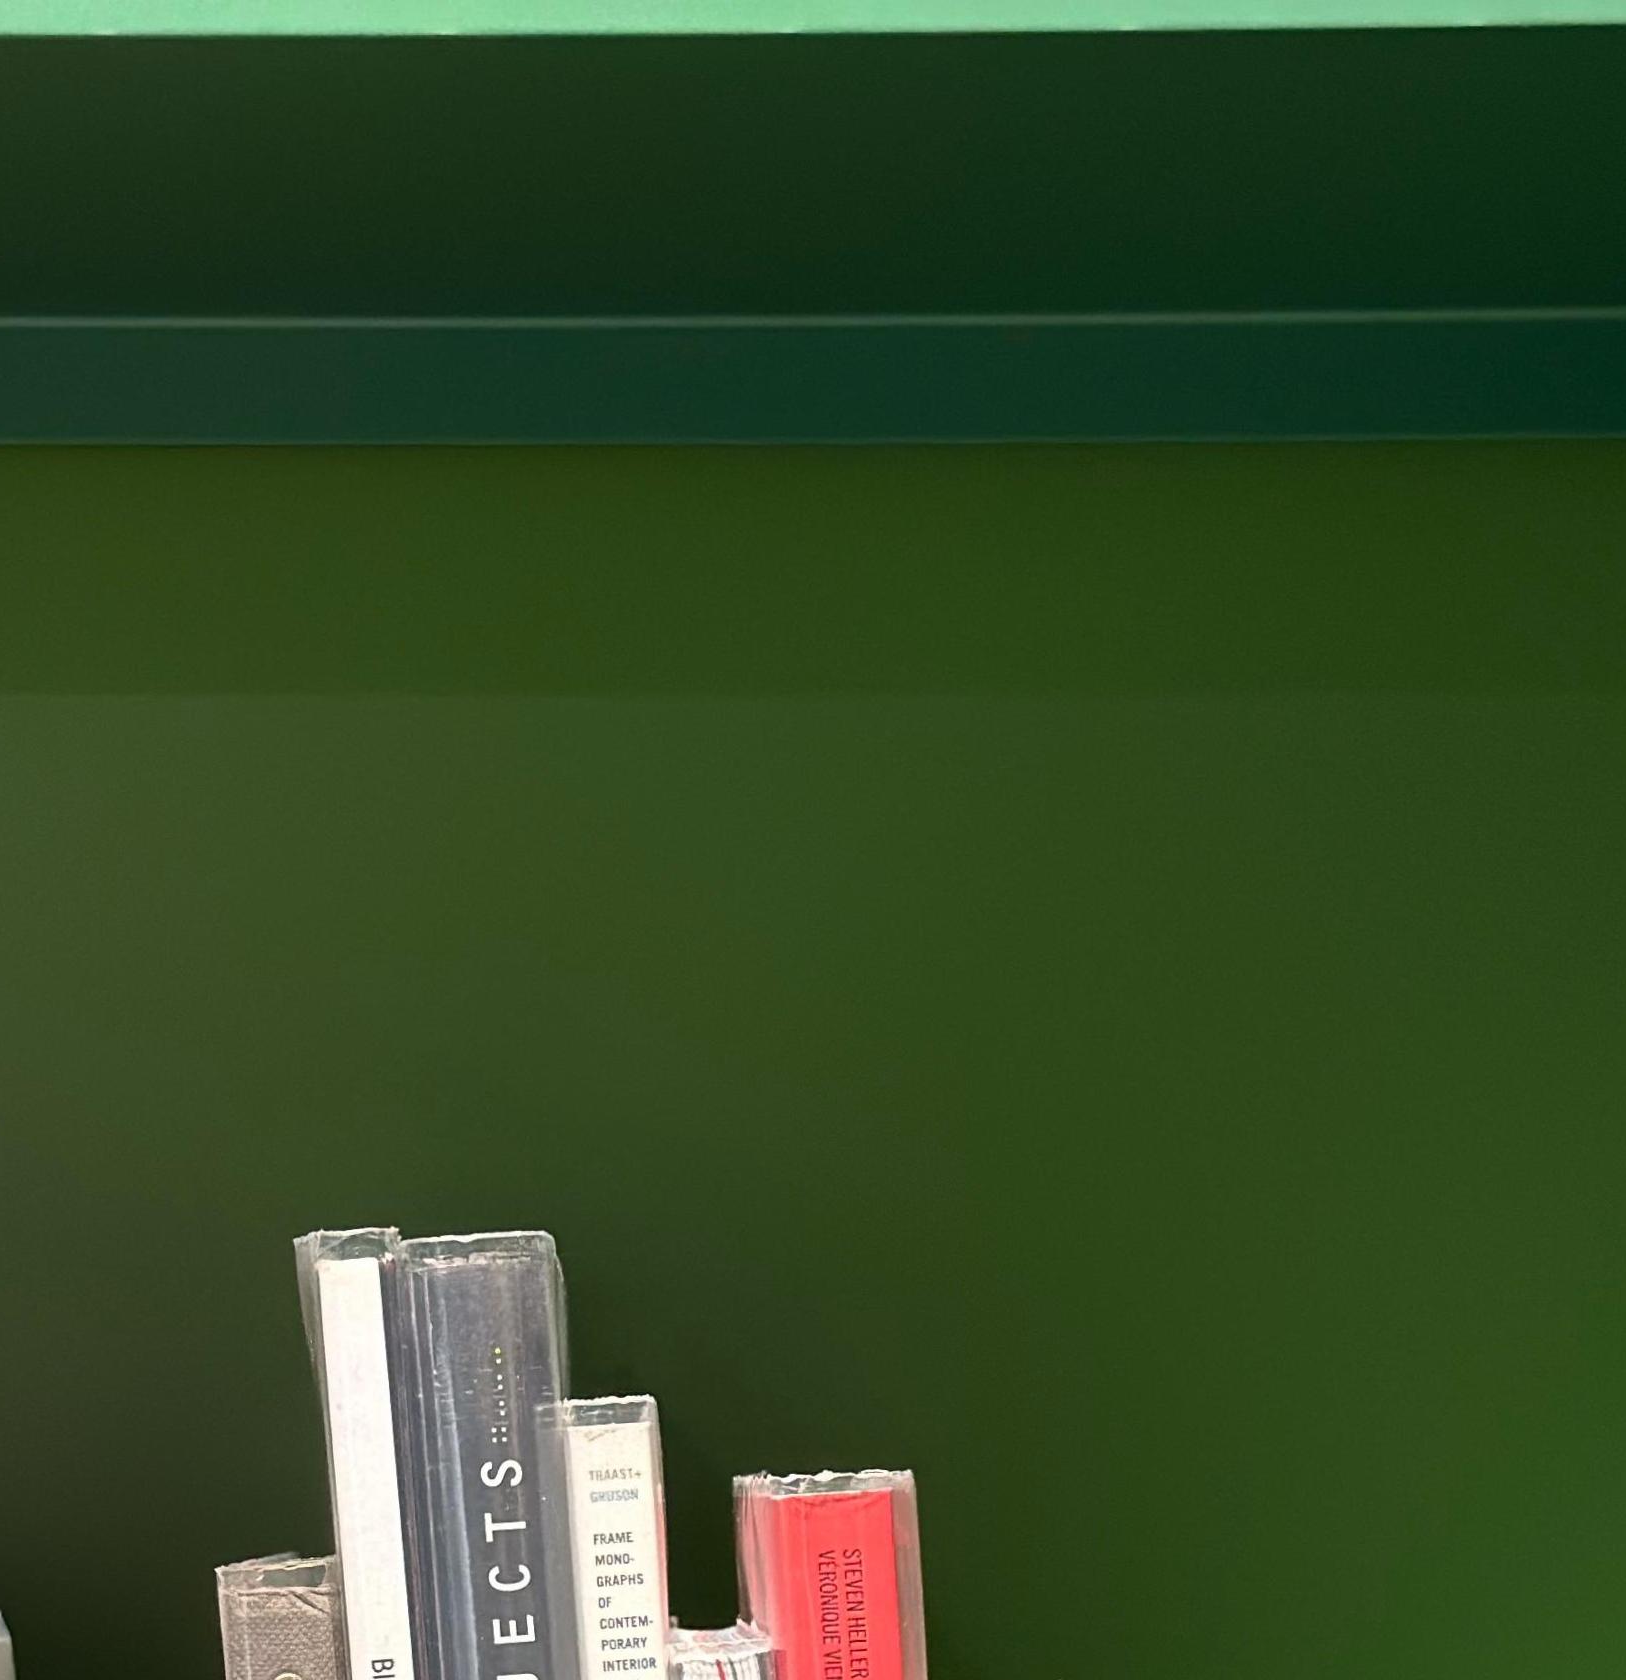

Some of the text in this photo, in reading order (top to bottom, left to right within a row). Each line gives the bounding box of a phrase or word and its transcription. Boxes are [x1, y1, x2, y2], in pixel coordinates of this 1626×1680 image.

[593, 1531, 634, 1545] FRAME
[594, 1552, 635, 1567] MONO-
[596, 1572, 645, 1588] GRAPHS
[597, 1597, 613, 1609] OF
[818, 1549, 842, 1646] VÉRONIQUE
[842, 1548, 870, 1679] STEVEN HELLER
[599, 1615, 654, 1630] CONTEM-
[601, 1636, 648, 1651] PORARY
[602, 1656, 658, 1673] INTERIOR
